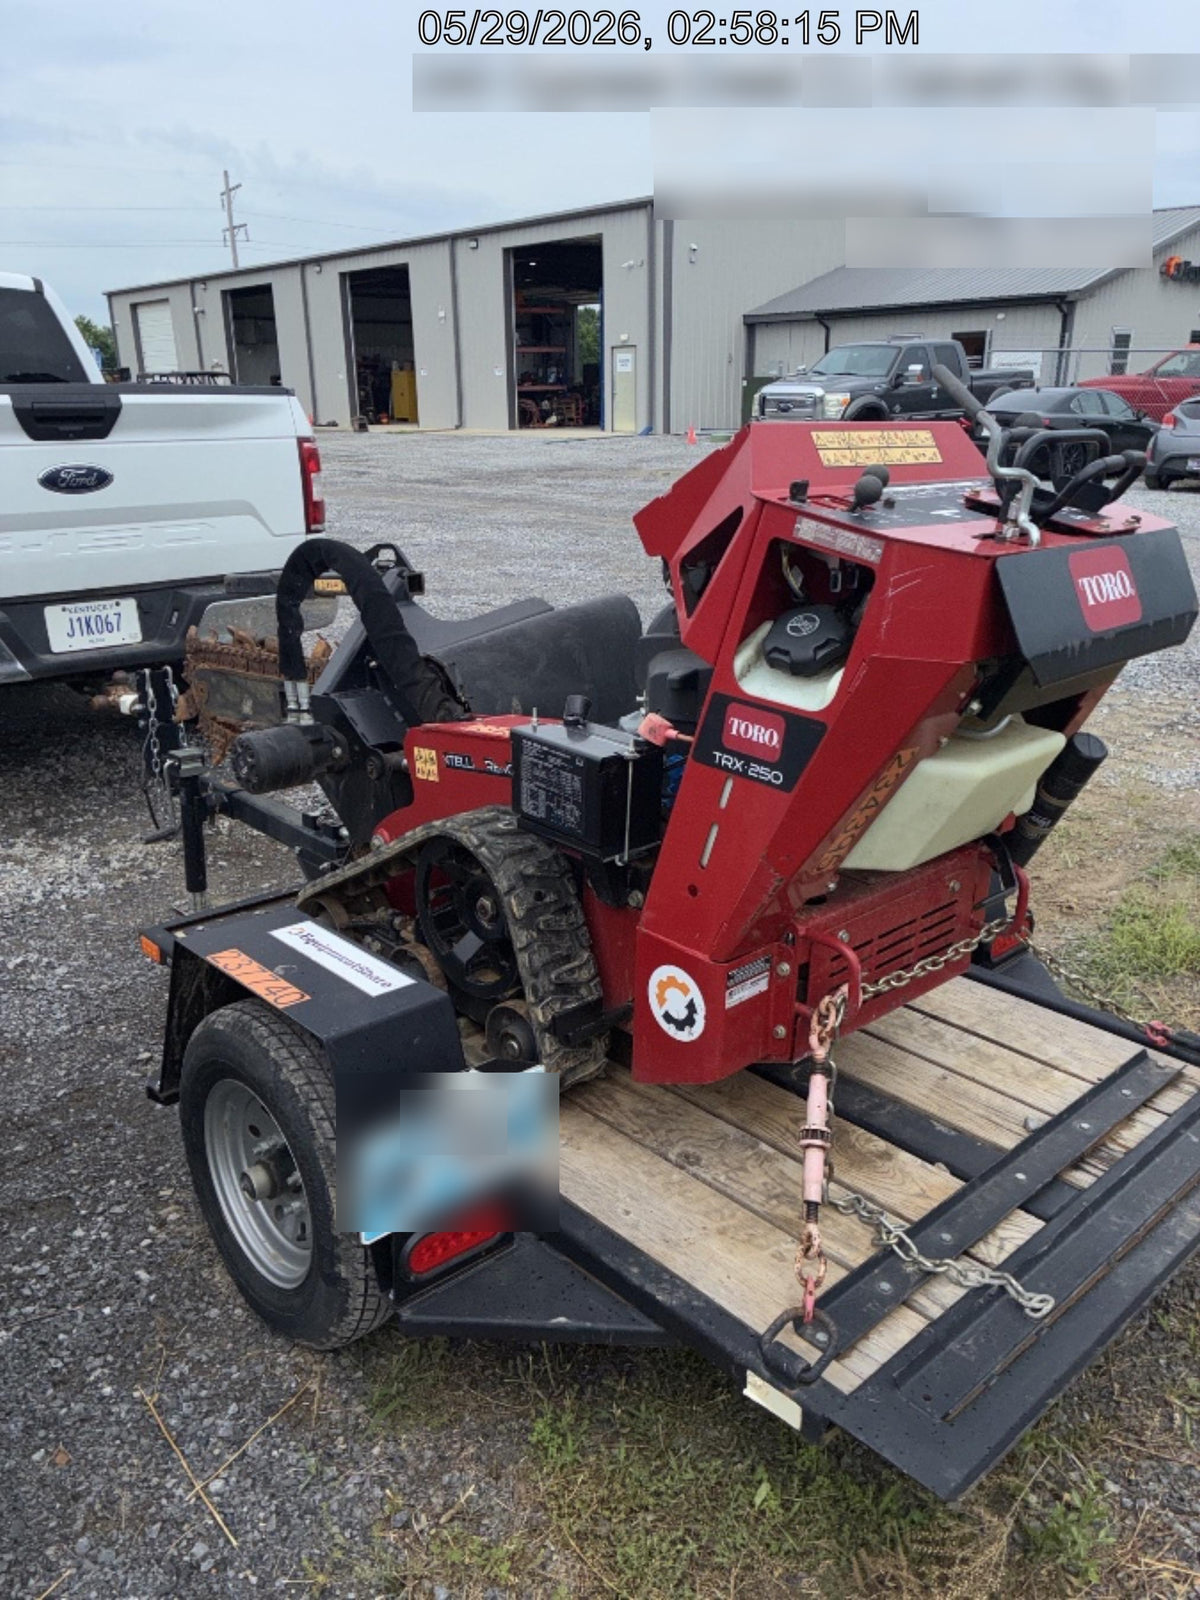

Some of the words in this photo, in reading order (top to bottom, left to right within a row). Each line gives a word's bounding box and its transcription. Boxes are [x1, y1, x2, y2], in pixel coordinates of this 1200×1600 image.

[57, 469, 98, 487] Ford
[1079, 570, 1131, 606] TORO
[66, 603, 115, 615] KENTUCKY
[66, 612, 122, 638] J1K067
[728, 717, 779, 748] TORO
[300, 932, 392, 988] EquipmentShare
[209, 950, 305, 1006] 237740
